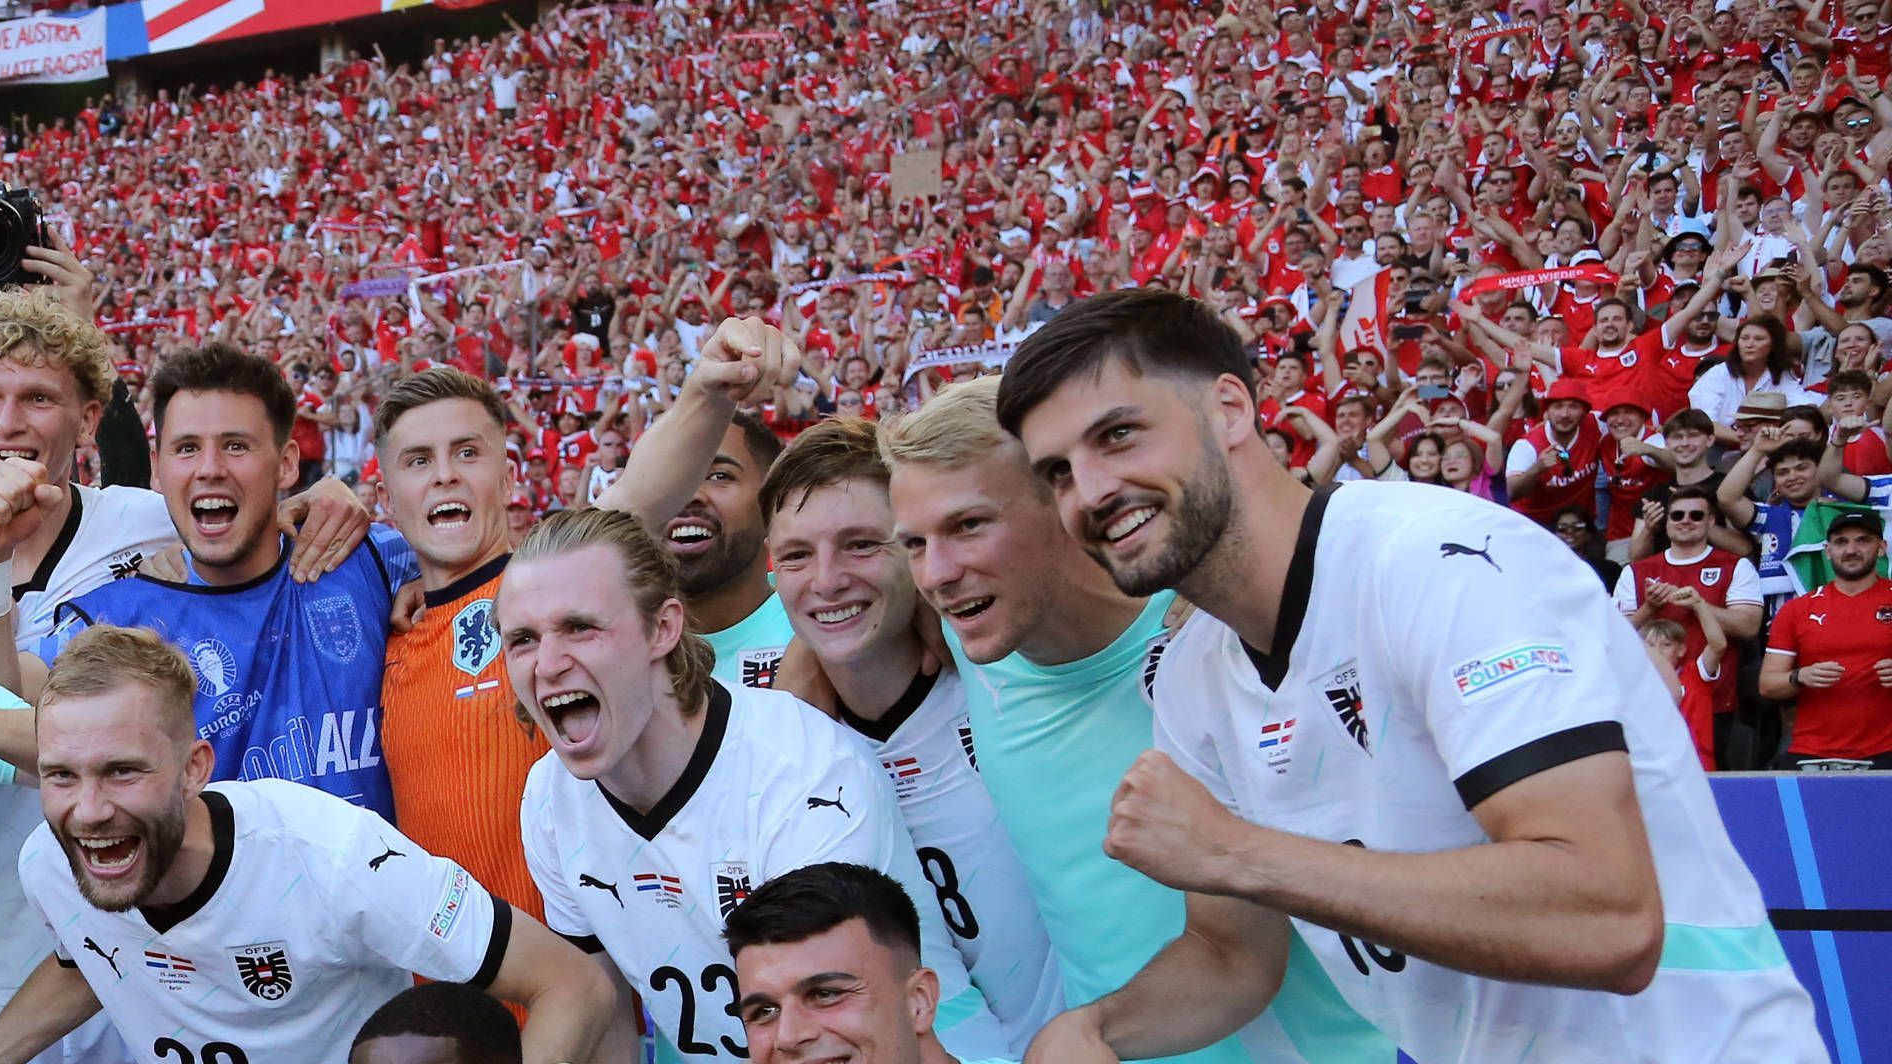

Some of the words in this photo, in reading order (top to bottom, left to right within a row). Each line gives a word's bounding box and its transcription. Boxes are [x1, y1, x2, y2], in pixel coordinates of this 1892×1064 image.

[16, 22, 81, 46] AUSTRIA
[44, 47, 105, 74] RACISM
[1453, 660, 1482, 678] UEFA
[214, 694, 242, 713] UEFA
[918, 846, 979, 940] 8
